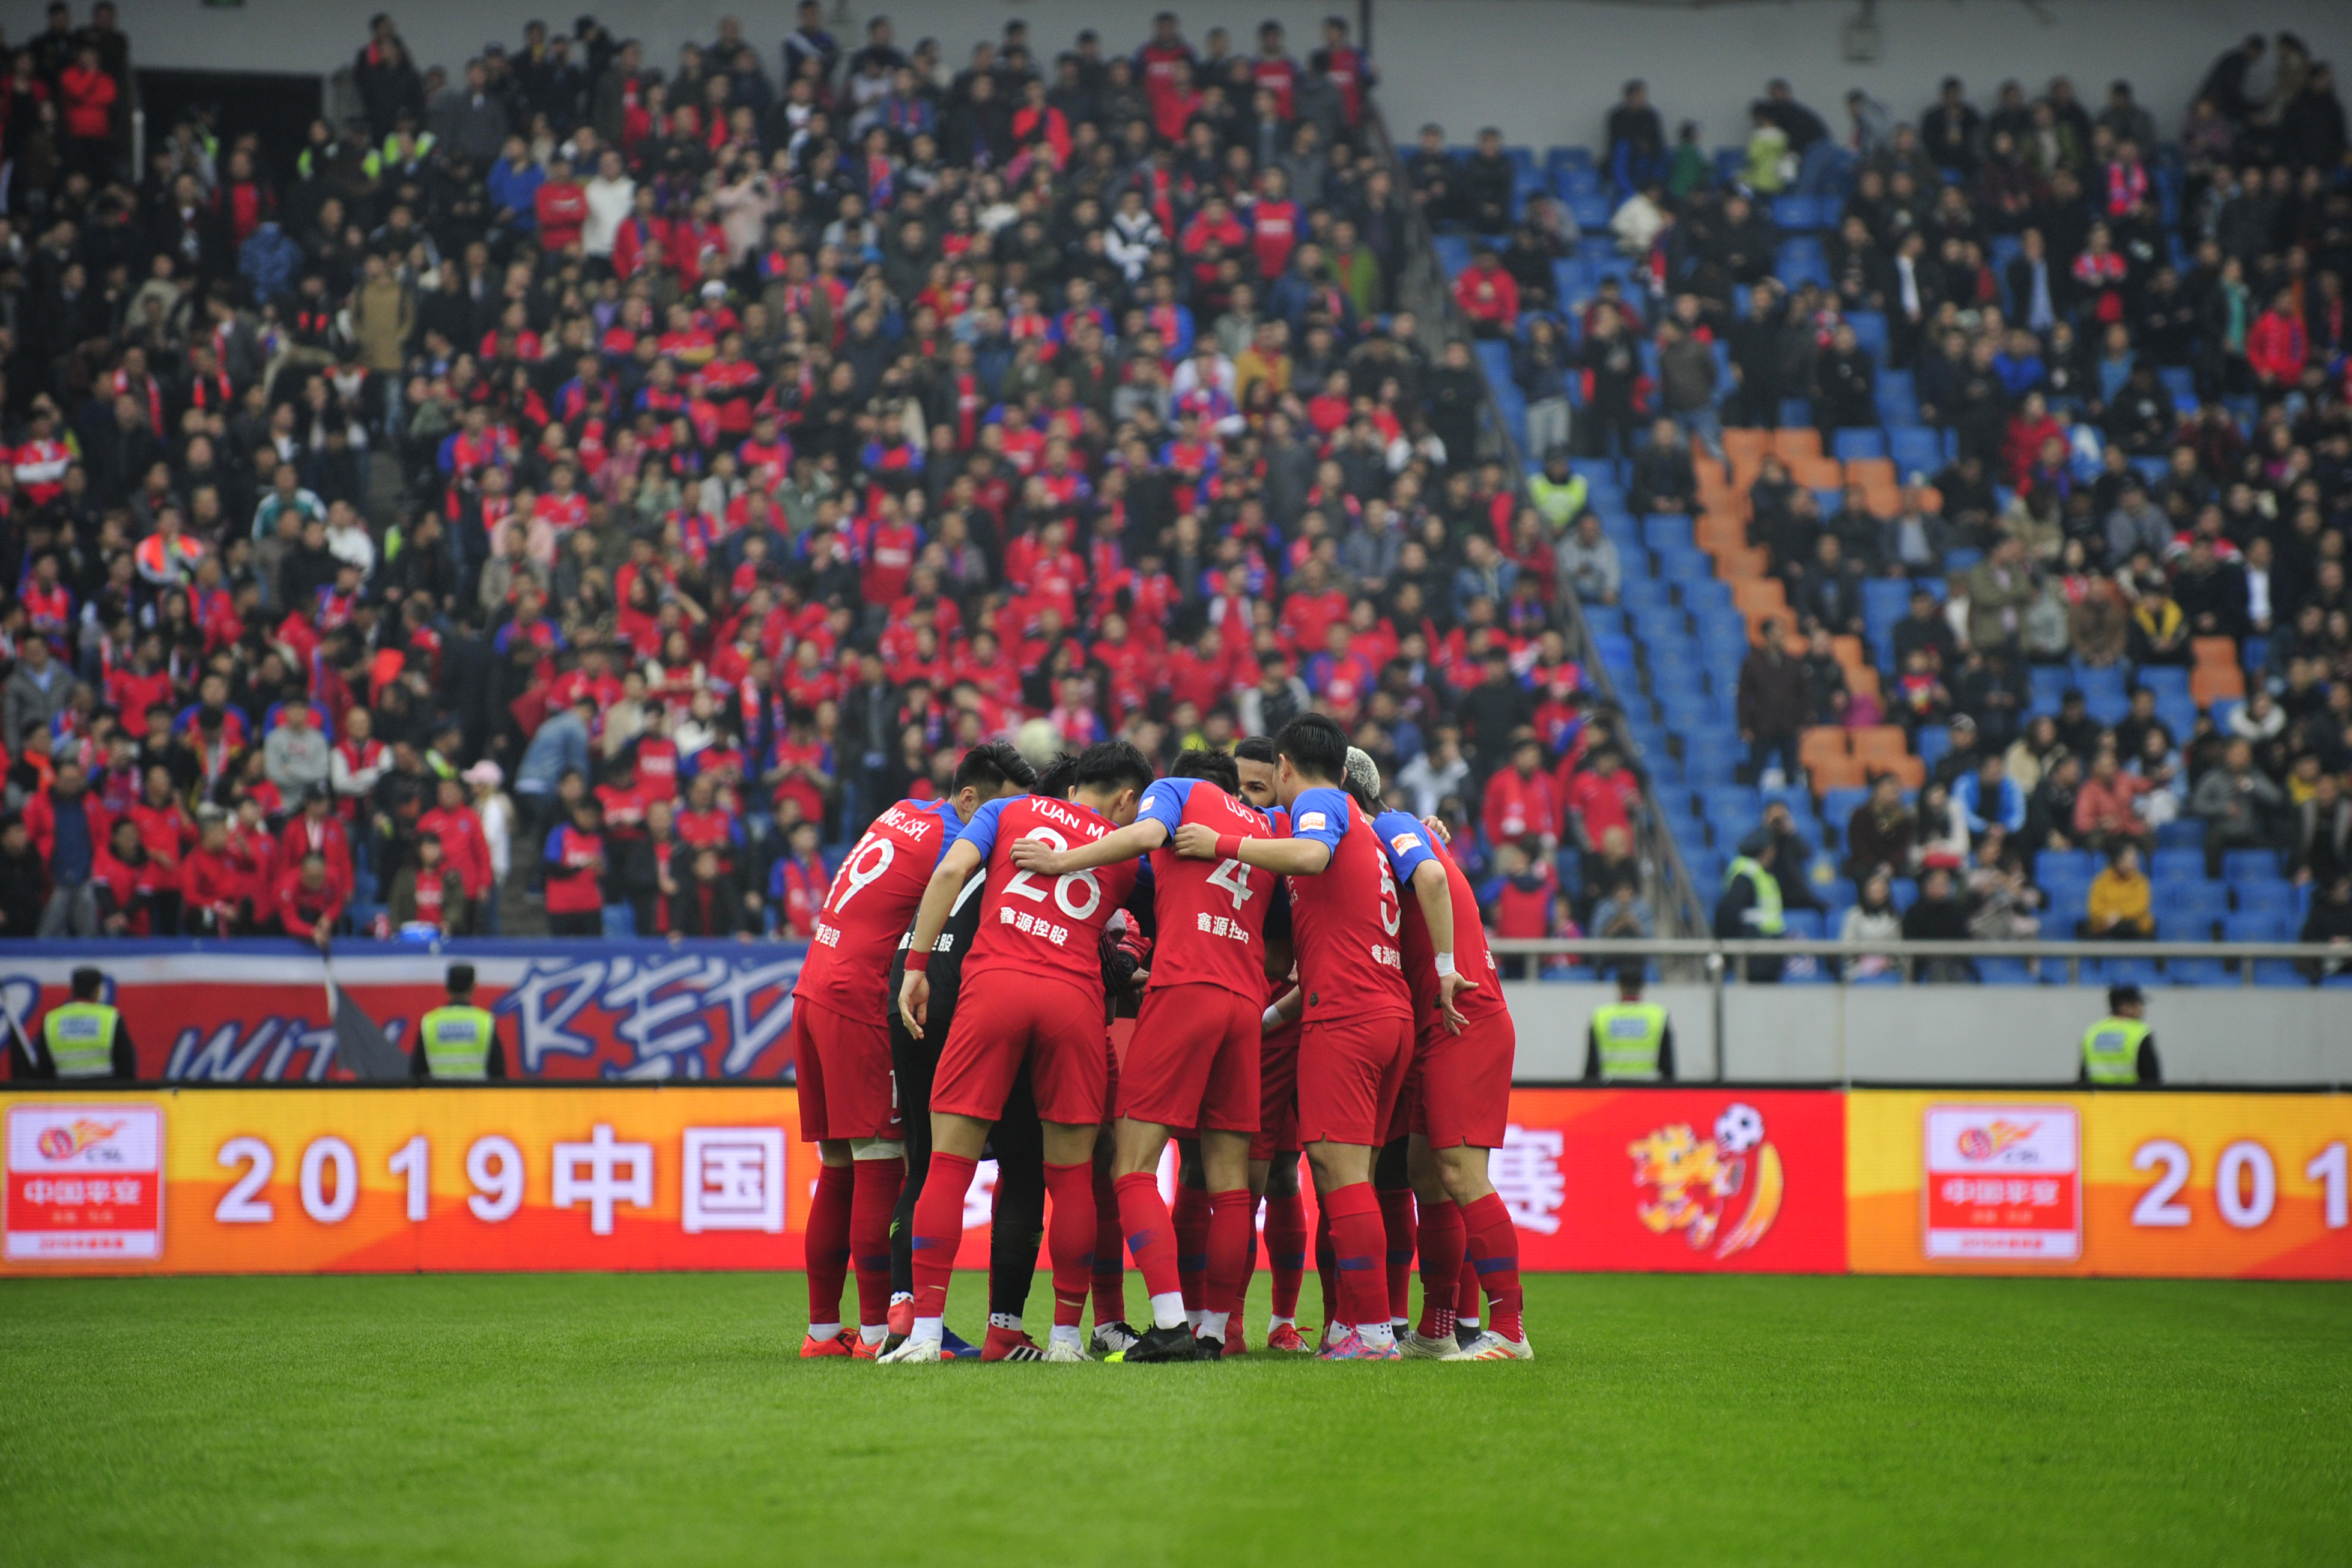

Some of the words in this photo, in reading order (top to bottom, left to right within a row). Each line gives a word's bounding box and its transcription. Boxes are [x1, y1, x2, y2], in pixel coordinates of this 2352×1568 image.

[1031, 798, 1080, 829] YUAN
[1223, 795, 1254, 823] LUO
[823, 831, 894, 914] 19
[1205, 833, 1253, 910] 4
[999, 906, 1068, 946] 鑫源控股
[2132, 1139, 2349, 1229] 201
